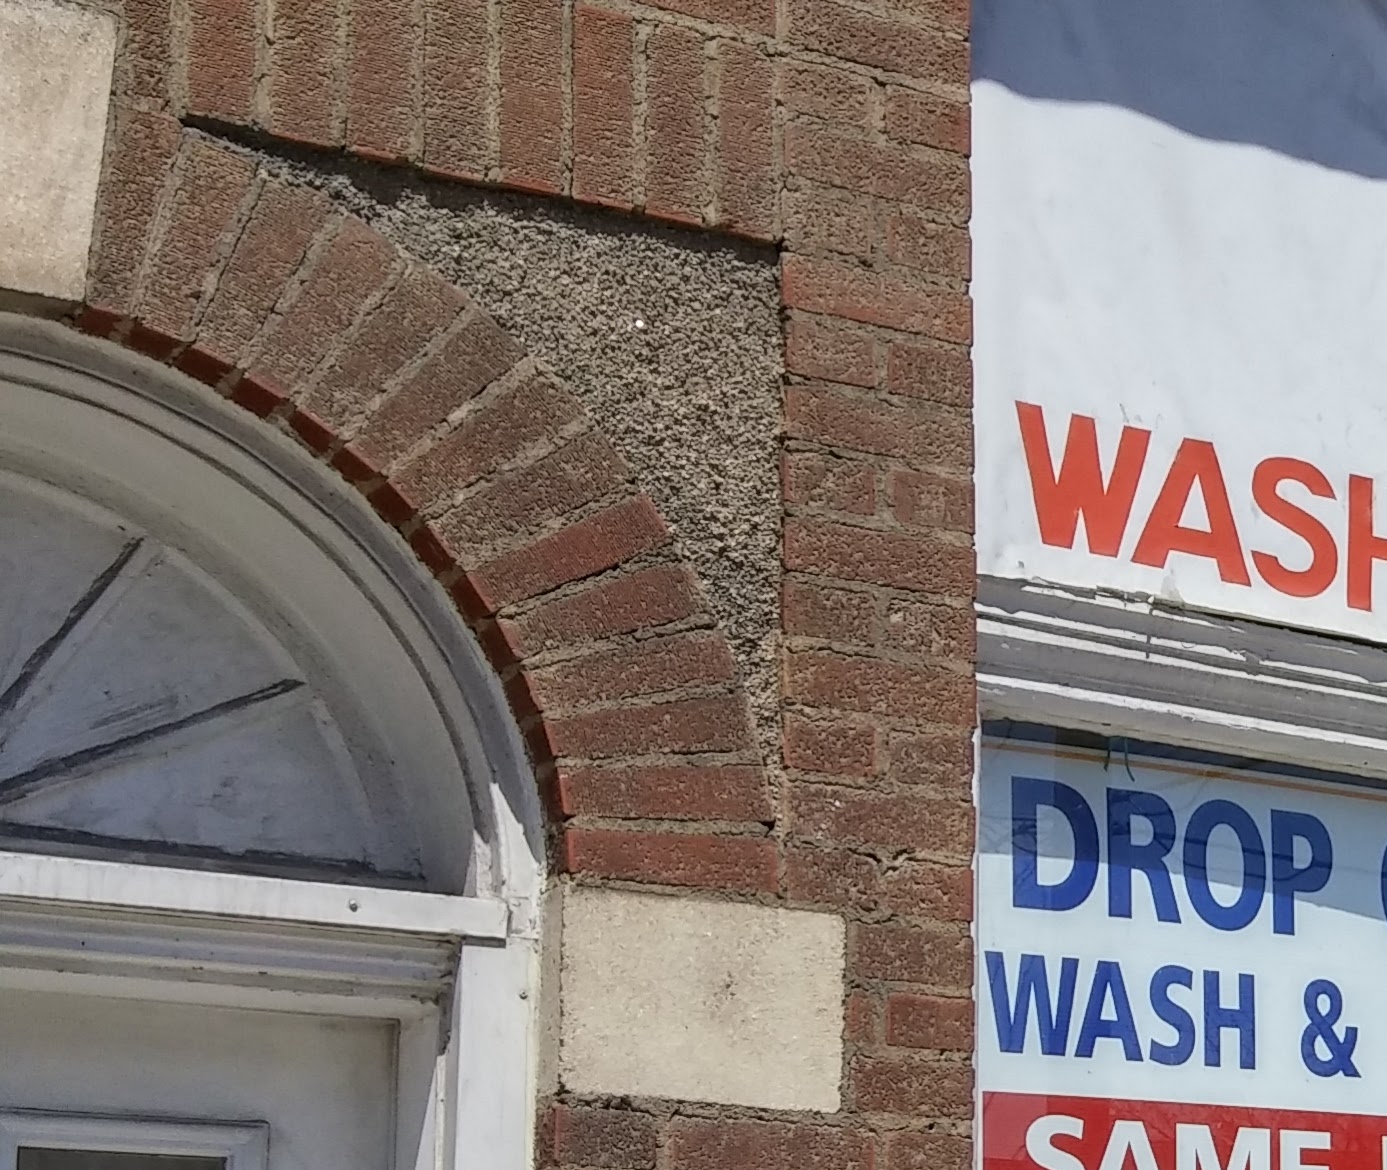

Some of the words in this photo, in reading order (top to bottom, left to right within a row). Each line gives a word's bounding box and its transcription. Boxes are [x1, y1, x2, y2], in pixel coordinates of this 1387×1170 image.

[1010, 776, 1333, 935] DROP
[984, 950, 1256, 1070] WASH
[1301, 979, 1362, 1078] &
